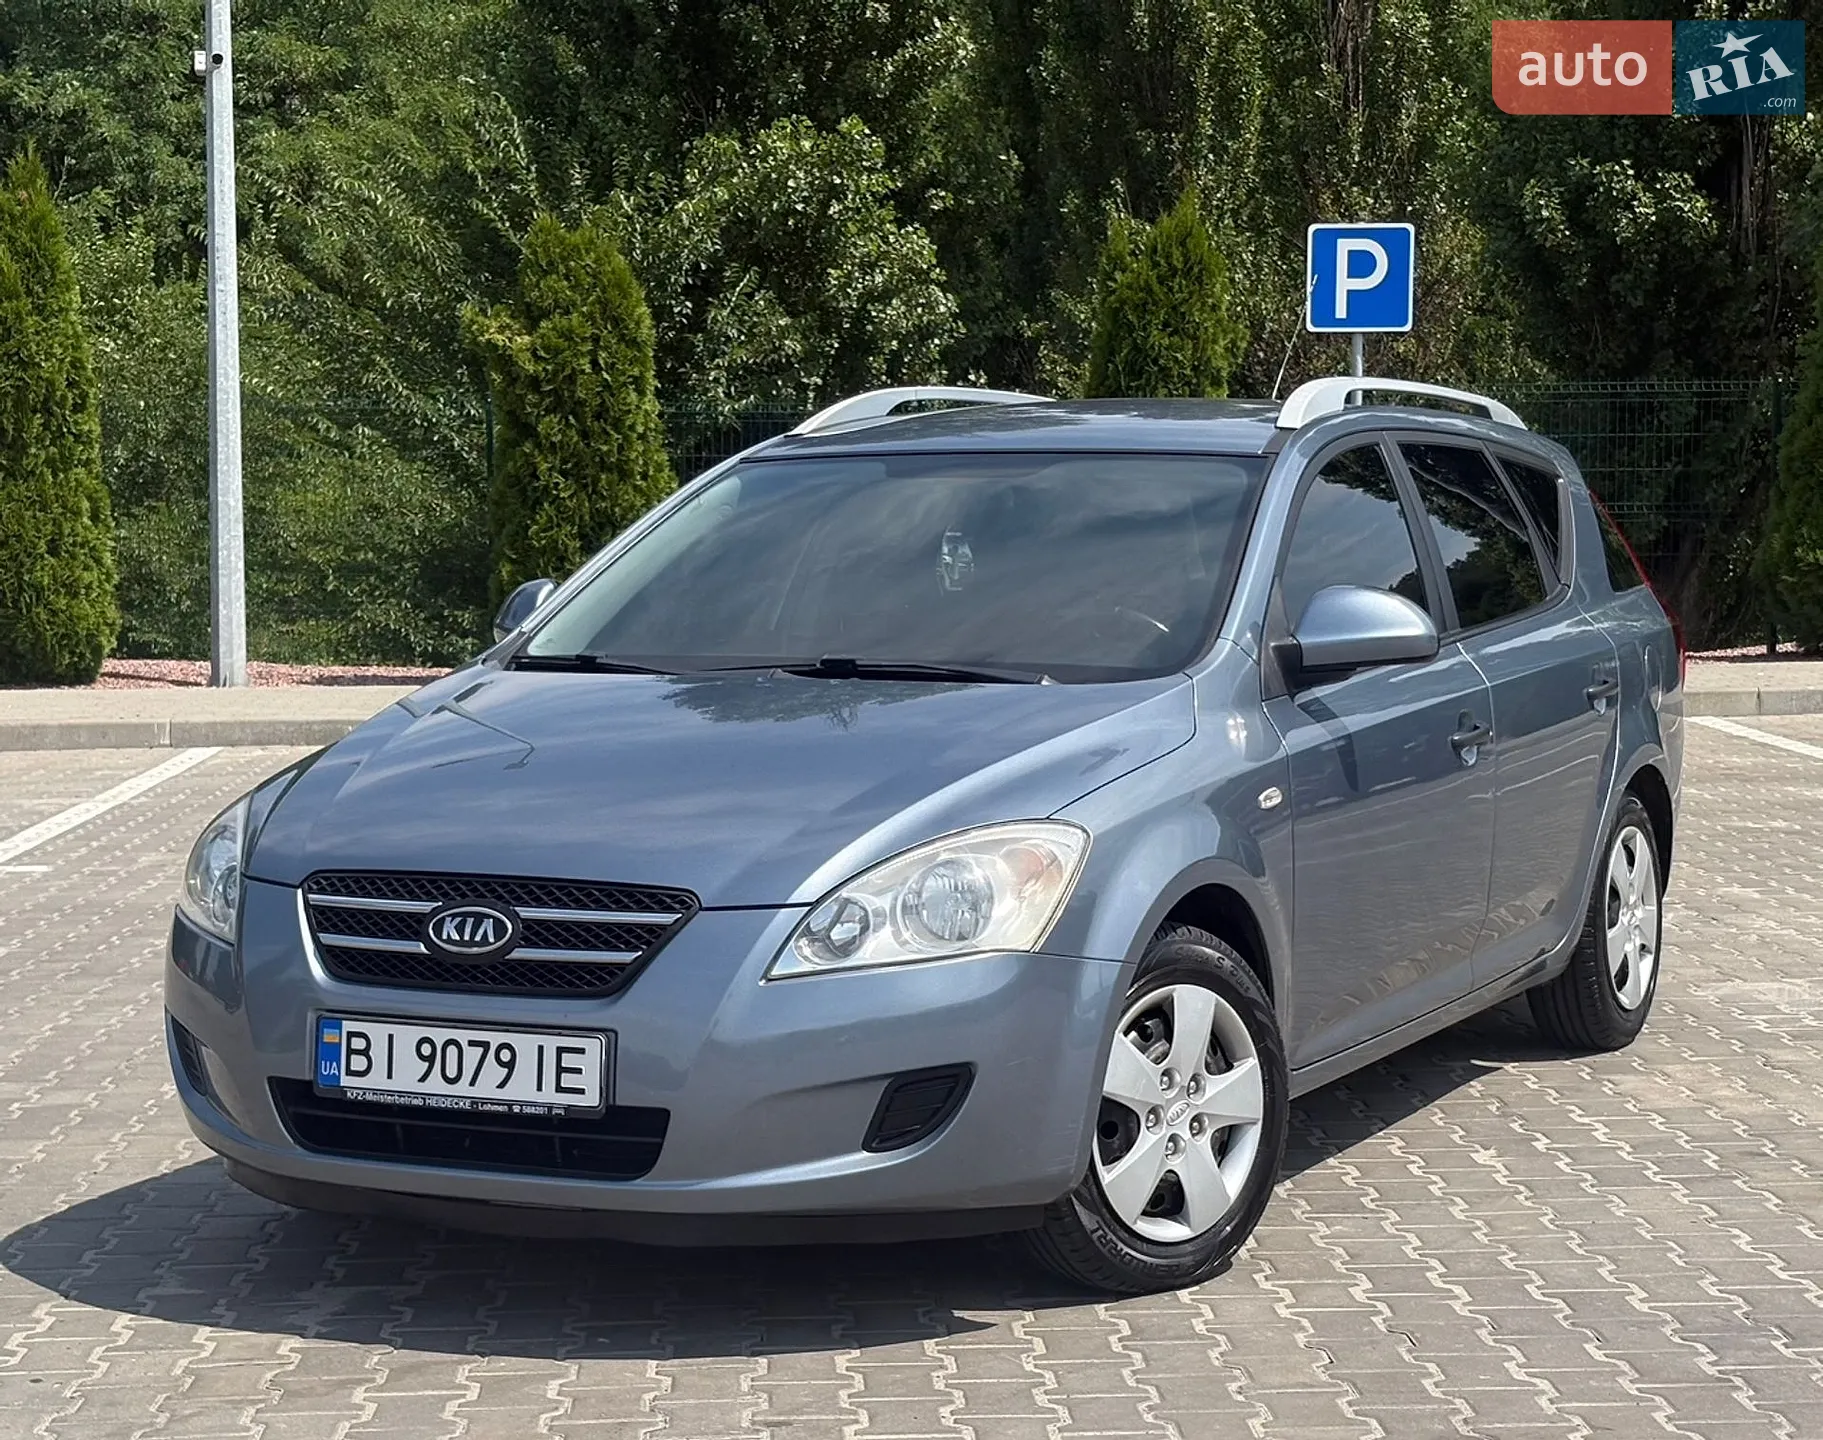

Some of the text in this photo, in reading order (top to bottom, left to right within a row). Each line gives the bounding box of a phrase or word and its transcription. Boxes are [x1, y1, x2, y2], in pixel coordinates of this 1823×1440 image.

[1335, 238, 1388, 319] P
[442, 917, 495, 943] KIA
[321, 1060, 339, 1076] UA
[345, 1030, 587, 1095] BI 9079 IE
